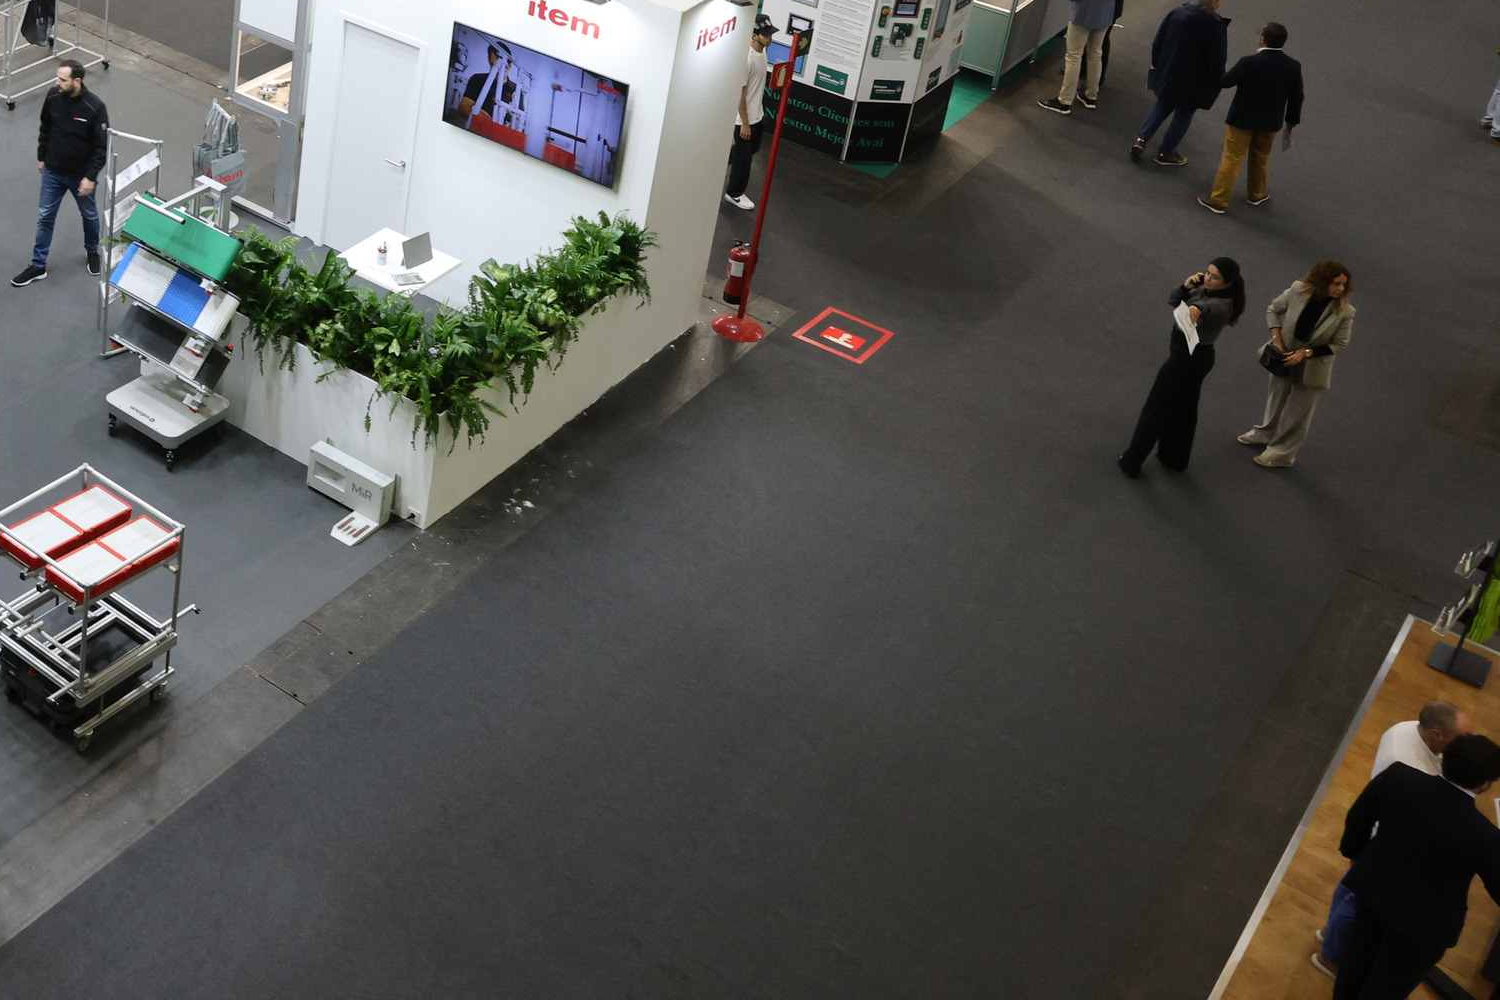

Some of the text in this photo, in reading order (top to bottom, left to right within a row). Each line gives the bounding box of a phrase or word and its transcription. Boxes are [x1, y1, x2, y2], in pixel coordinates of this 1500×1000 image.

[695, 14, 738, 51] item
[763, 86, 815, 113] Nustros
[764, 106, 812, 134] Nestro
[856, 137, 885, 148] Aval
[351, 482, 373, 502] MiR
